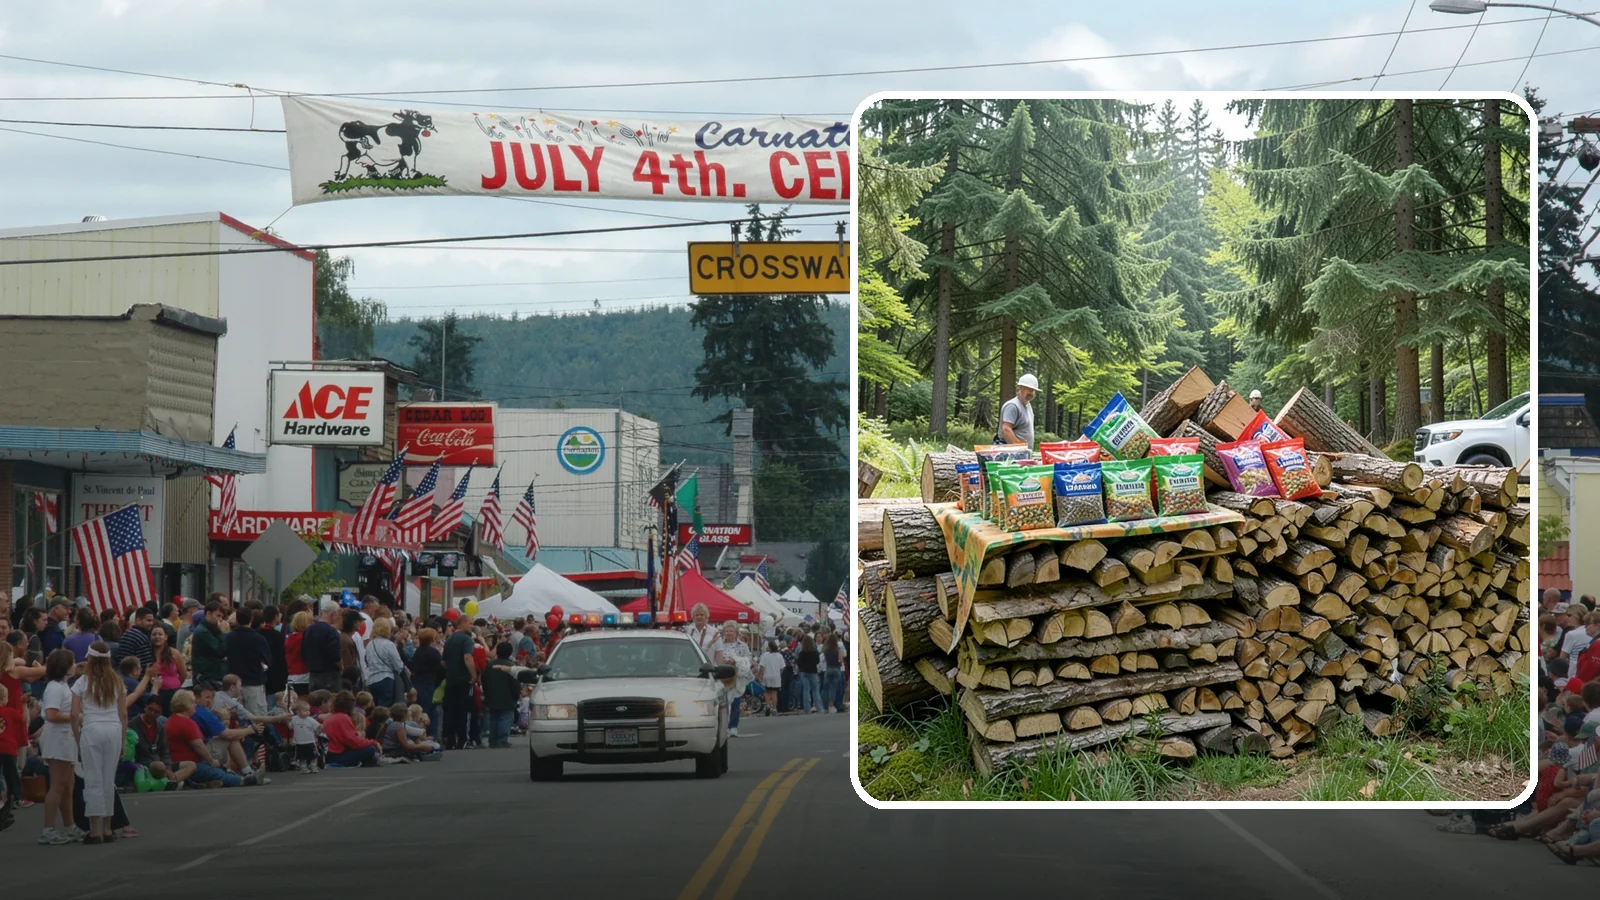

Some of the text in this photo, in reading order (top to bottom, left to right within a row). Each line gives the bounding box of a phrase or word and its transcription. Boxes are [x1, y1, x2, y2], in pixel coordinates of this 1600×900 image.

[695, 121, 850, 149] Carnat
[481, 141, 605, 192] JULY
[632, 150, 746, 198] 4th.
[697, 254, 850, 280] CROSSWA
[283, 380, 373, 420] ACE
[405, 410, 452, 422] CEDAR
[283, 421, 371, 436] Hardware
[95, 485, 124, 495] Vincent
[126, 486, 136, 495] de
[137, 486, 155, 495] Paul
[688, 526, 741, 535] CRNATION
